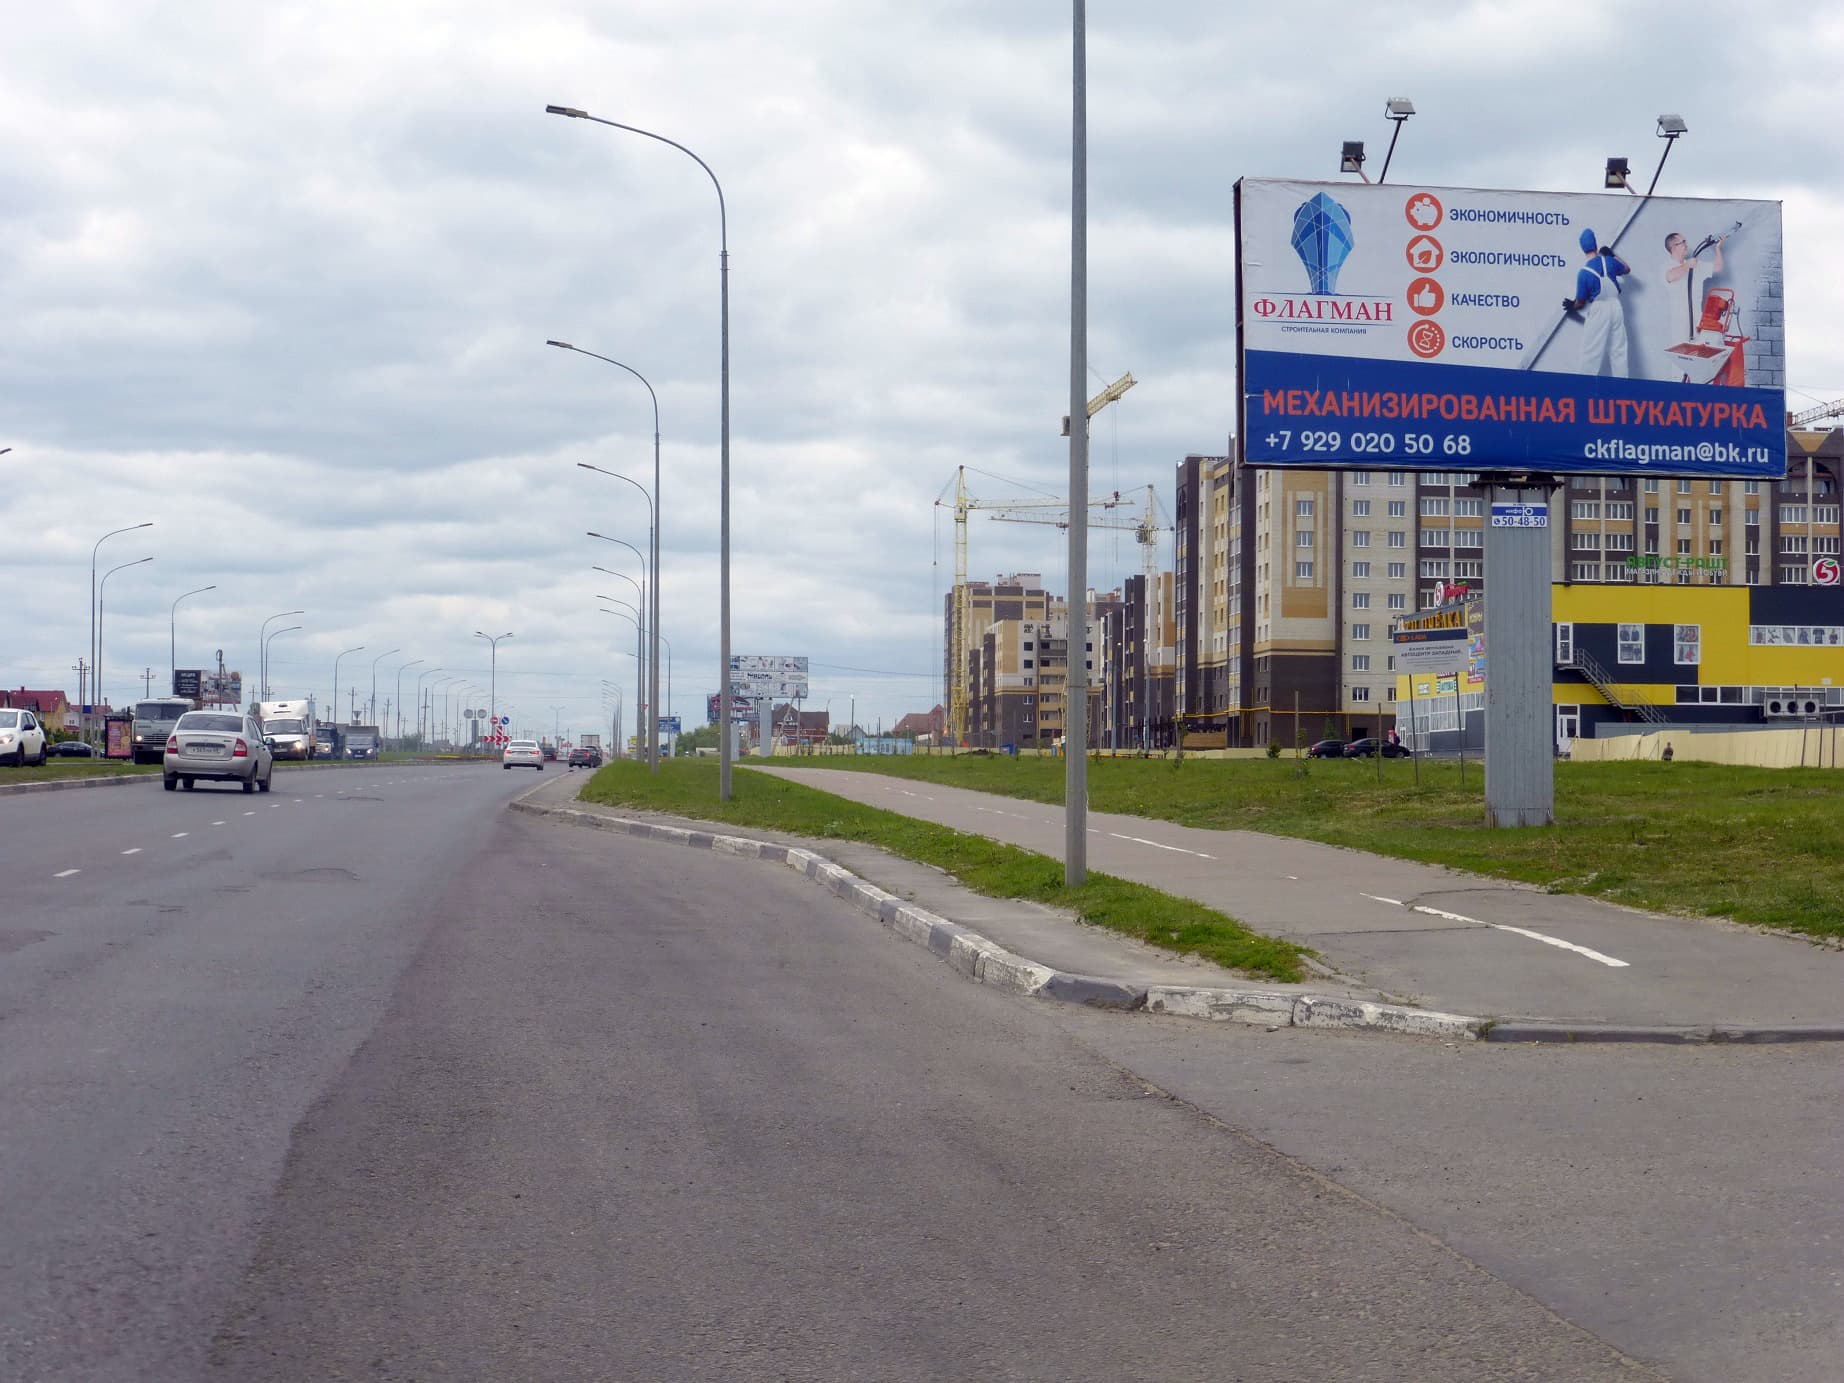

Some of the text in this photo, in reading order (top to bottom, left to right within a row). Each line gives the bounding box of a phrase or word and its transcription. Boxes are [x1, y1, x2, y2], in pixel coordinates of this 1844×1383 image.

[1449, 208, 1570, 226] ЭКОНОМИЧНОСТЬ
[1450, 250, 1566, 269] ЭКОЛОГИЧНОСТЬ
[1451, 293, 1521, 308] КАЧЕСТВО
[1253, 298, 1393, 322] ФЛАГМАН
[1281, 326, 1367, 335] СТРОИТЕЛЬНАЯ КОМПАНИЯ
[1452, 336, 1524, 351] СКОРОСТЬ
[1263, 389, 1768, 430] МЕХАНИЗИРОВАННАЯ ШТУКАТУРКА
[1264, 431, 1472, 456] +7 929 020 50 68
[1584, 440, 1770, 465] ckflagman@bk.ru
[1502, 516, 1545, 527] 50-48-50
